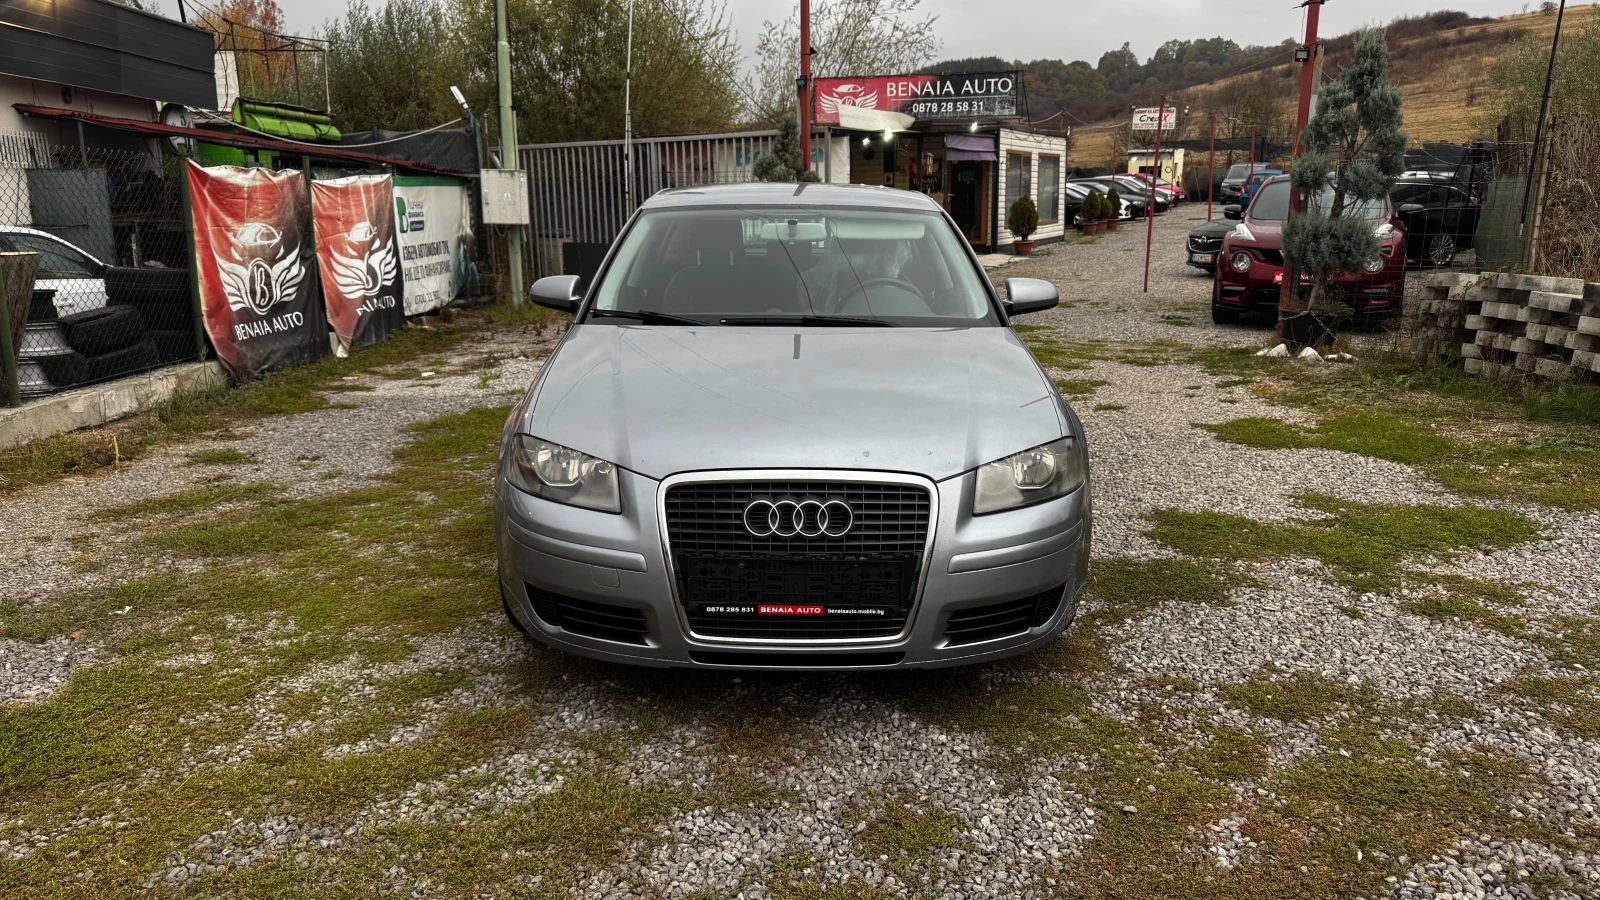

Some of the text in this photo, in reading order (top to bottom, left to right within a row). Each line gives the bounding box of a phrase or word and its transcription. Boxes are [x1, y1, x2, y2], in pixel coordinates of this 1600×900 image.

[886, 77, 1013, 97] BENAIA AUTO
[912, 101, 984, 113] 0878 28 58 31
[234, 311, 304, 341] BENAIA AUTO
[827, 607, 885, 616] benaiaauto.mobile.bg
